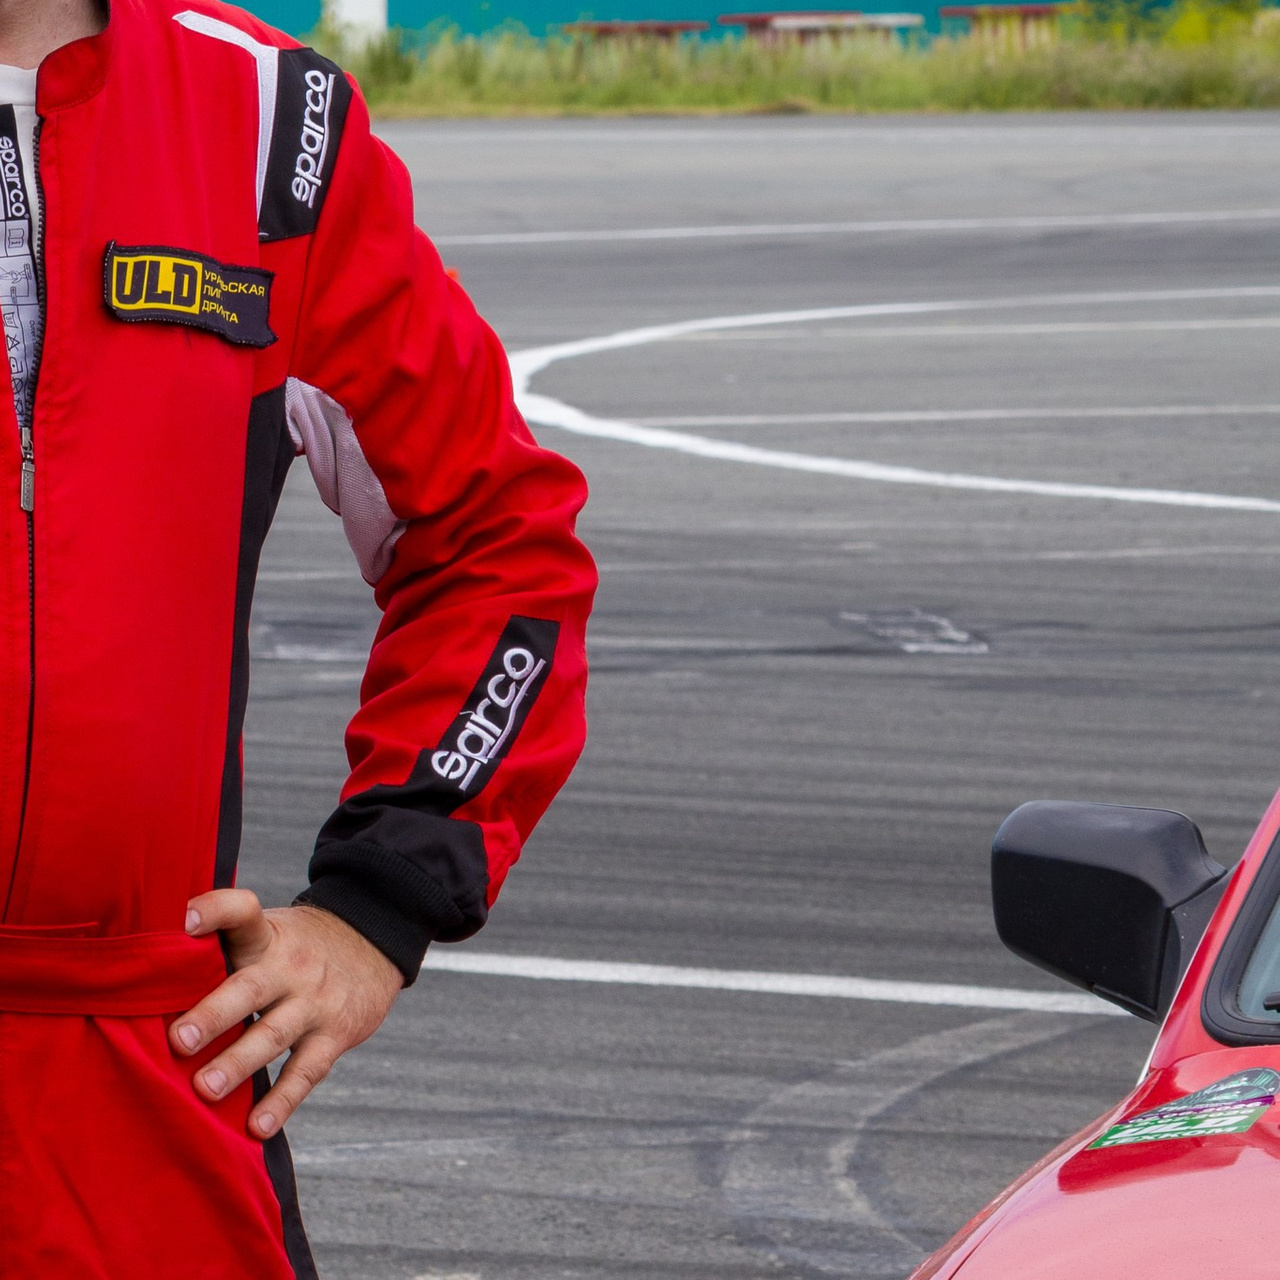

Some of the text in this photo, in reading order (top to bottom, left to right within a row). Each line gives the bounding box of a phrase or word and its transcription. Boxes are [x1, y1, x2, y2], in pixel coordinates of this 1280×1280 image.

[292, 70, 328, 202] sparco
[115, 260, 198, 308] ULD
[203, 284, 222, 299] ЛИГ
[204, 269, 265, 297] УРАЬСКАЯ
[202, 300, 239, 324] ДРИТА
